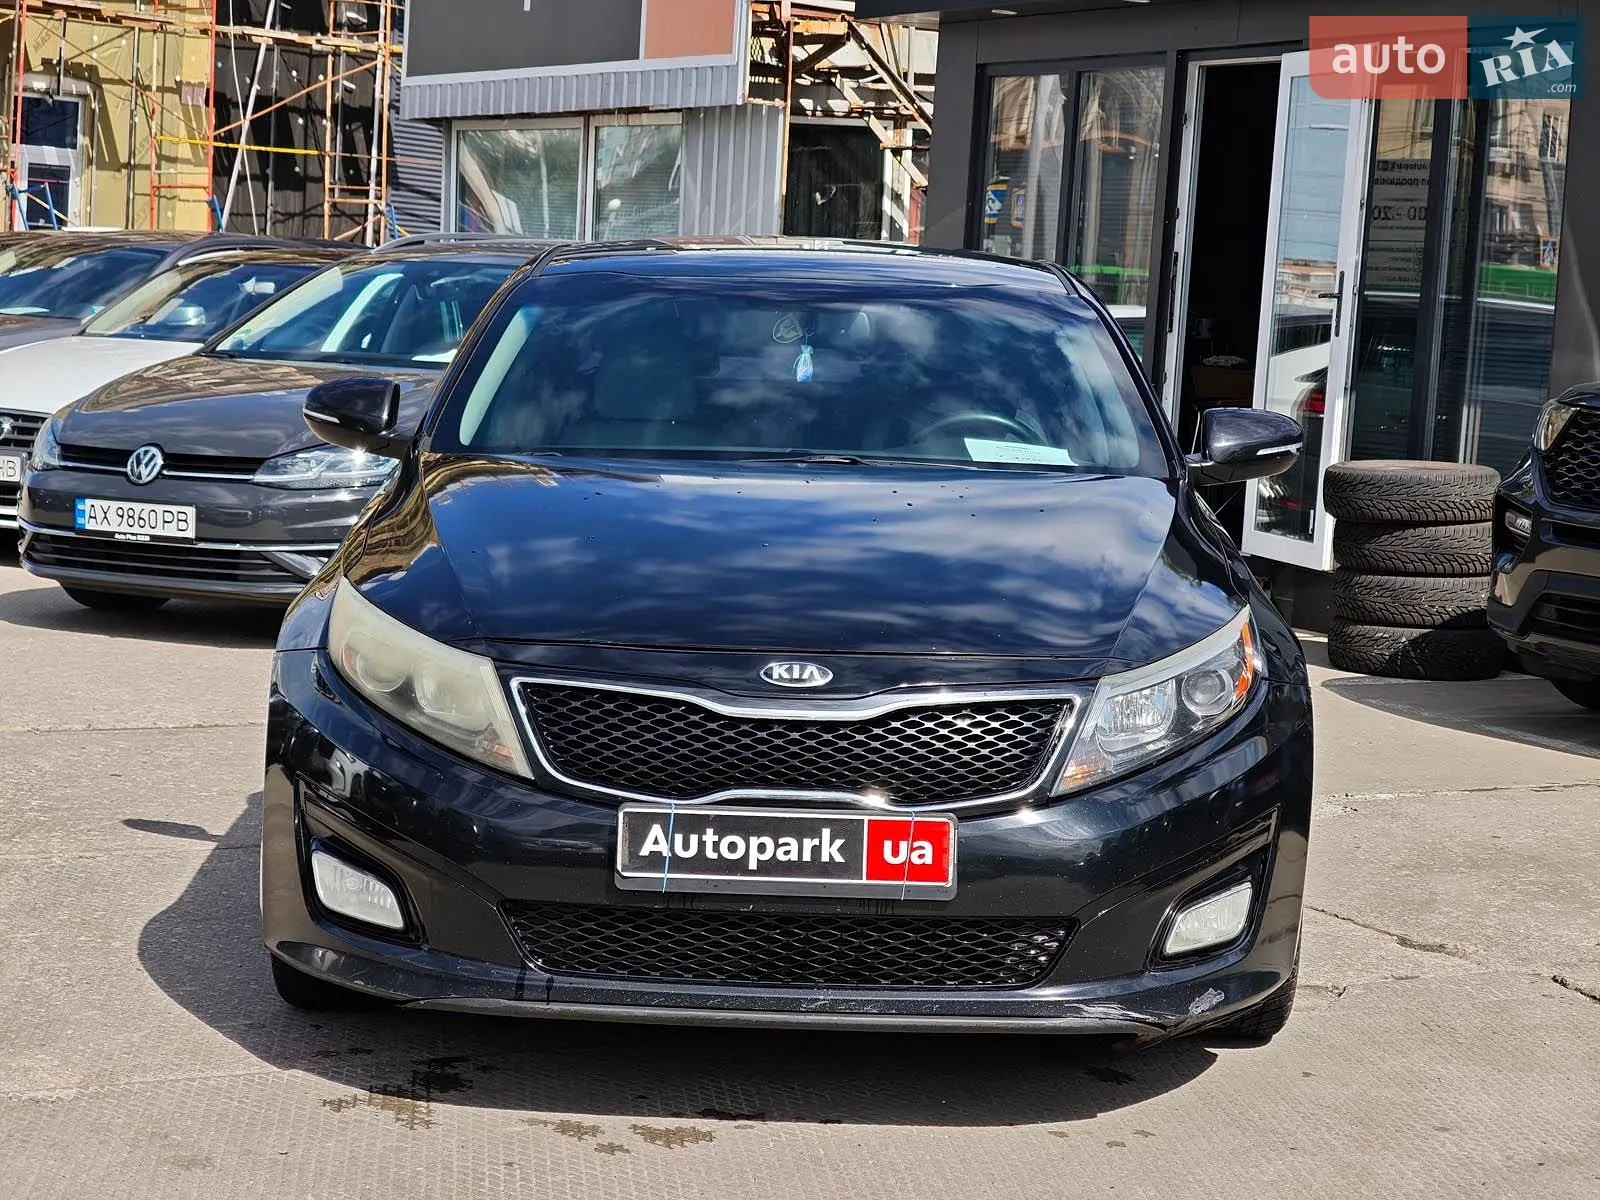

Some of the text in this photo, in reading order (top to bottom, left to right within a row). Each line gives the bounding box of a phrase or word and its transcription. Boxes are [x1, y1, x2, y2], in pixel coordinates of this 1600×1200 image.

[87, 504, 112, 527] AX
[115, 506, 158, 530] 9860
[162, 510, 189, 531] PB
[772, 663, 823, 681] KIA
[639, 823, 933, 870] Autopark ua
